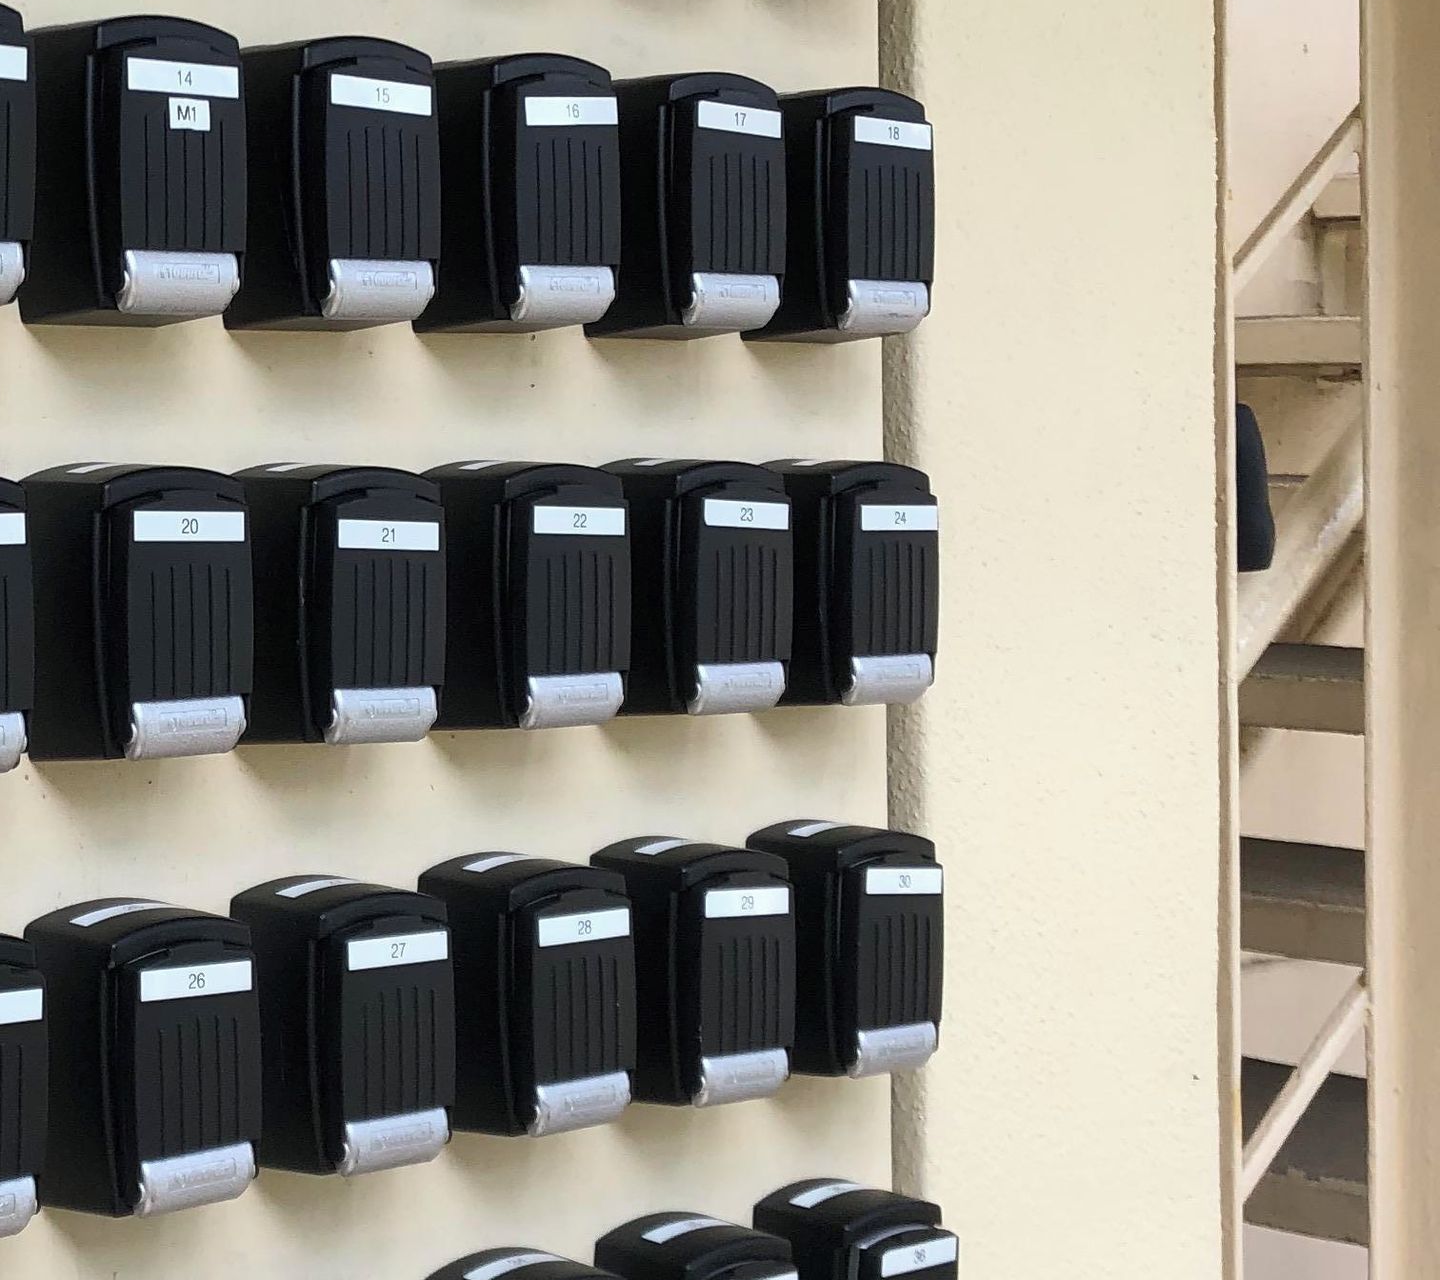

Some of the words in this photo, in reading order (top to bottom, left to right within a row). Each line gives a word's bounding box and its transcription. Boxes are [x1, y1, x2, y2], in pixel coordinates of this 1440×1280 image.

[177, 70, 193, 87] 14
[375, 87, 390, 104] 15
[176, 105, 200, 123] M1
[566, 103, 580, 119] 16
[734, 111, 747, 127] 17
[888, 126, 901, 141] 18
[573, 512, 588, 529] 22
[740, 506, 754, 523] 23
[894, 511, 907, 525] 24
[181, 518, 199, 535] 20
[381, 527, 395, 543] 21
[898, 874, 912, 889] 30
[741, 895, 755, 911] 29
[577, 919, 592, 936] 28
[390, 942, 407, 959] 27
[188, 972, 206, 990] 26
